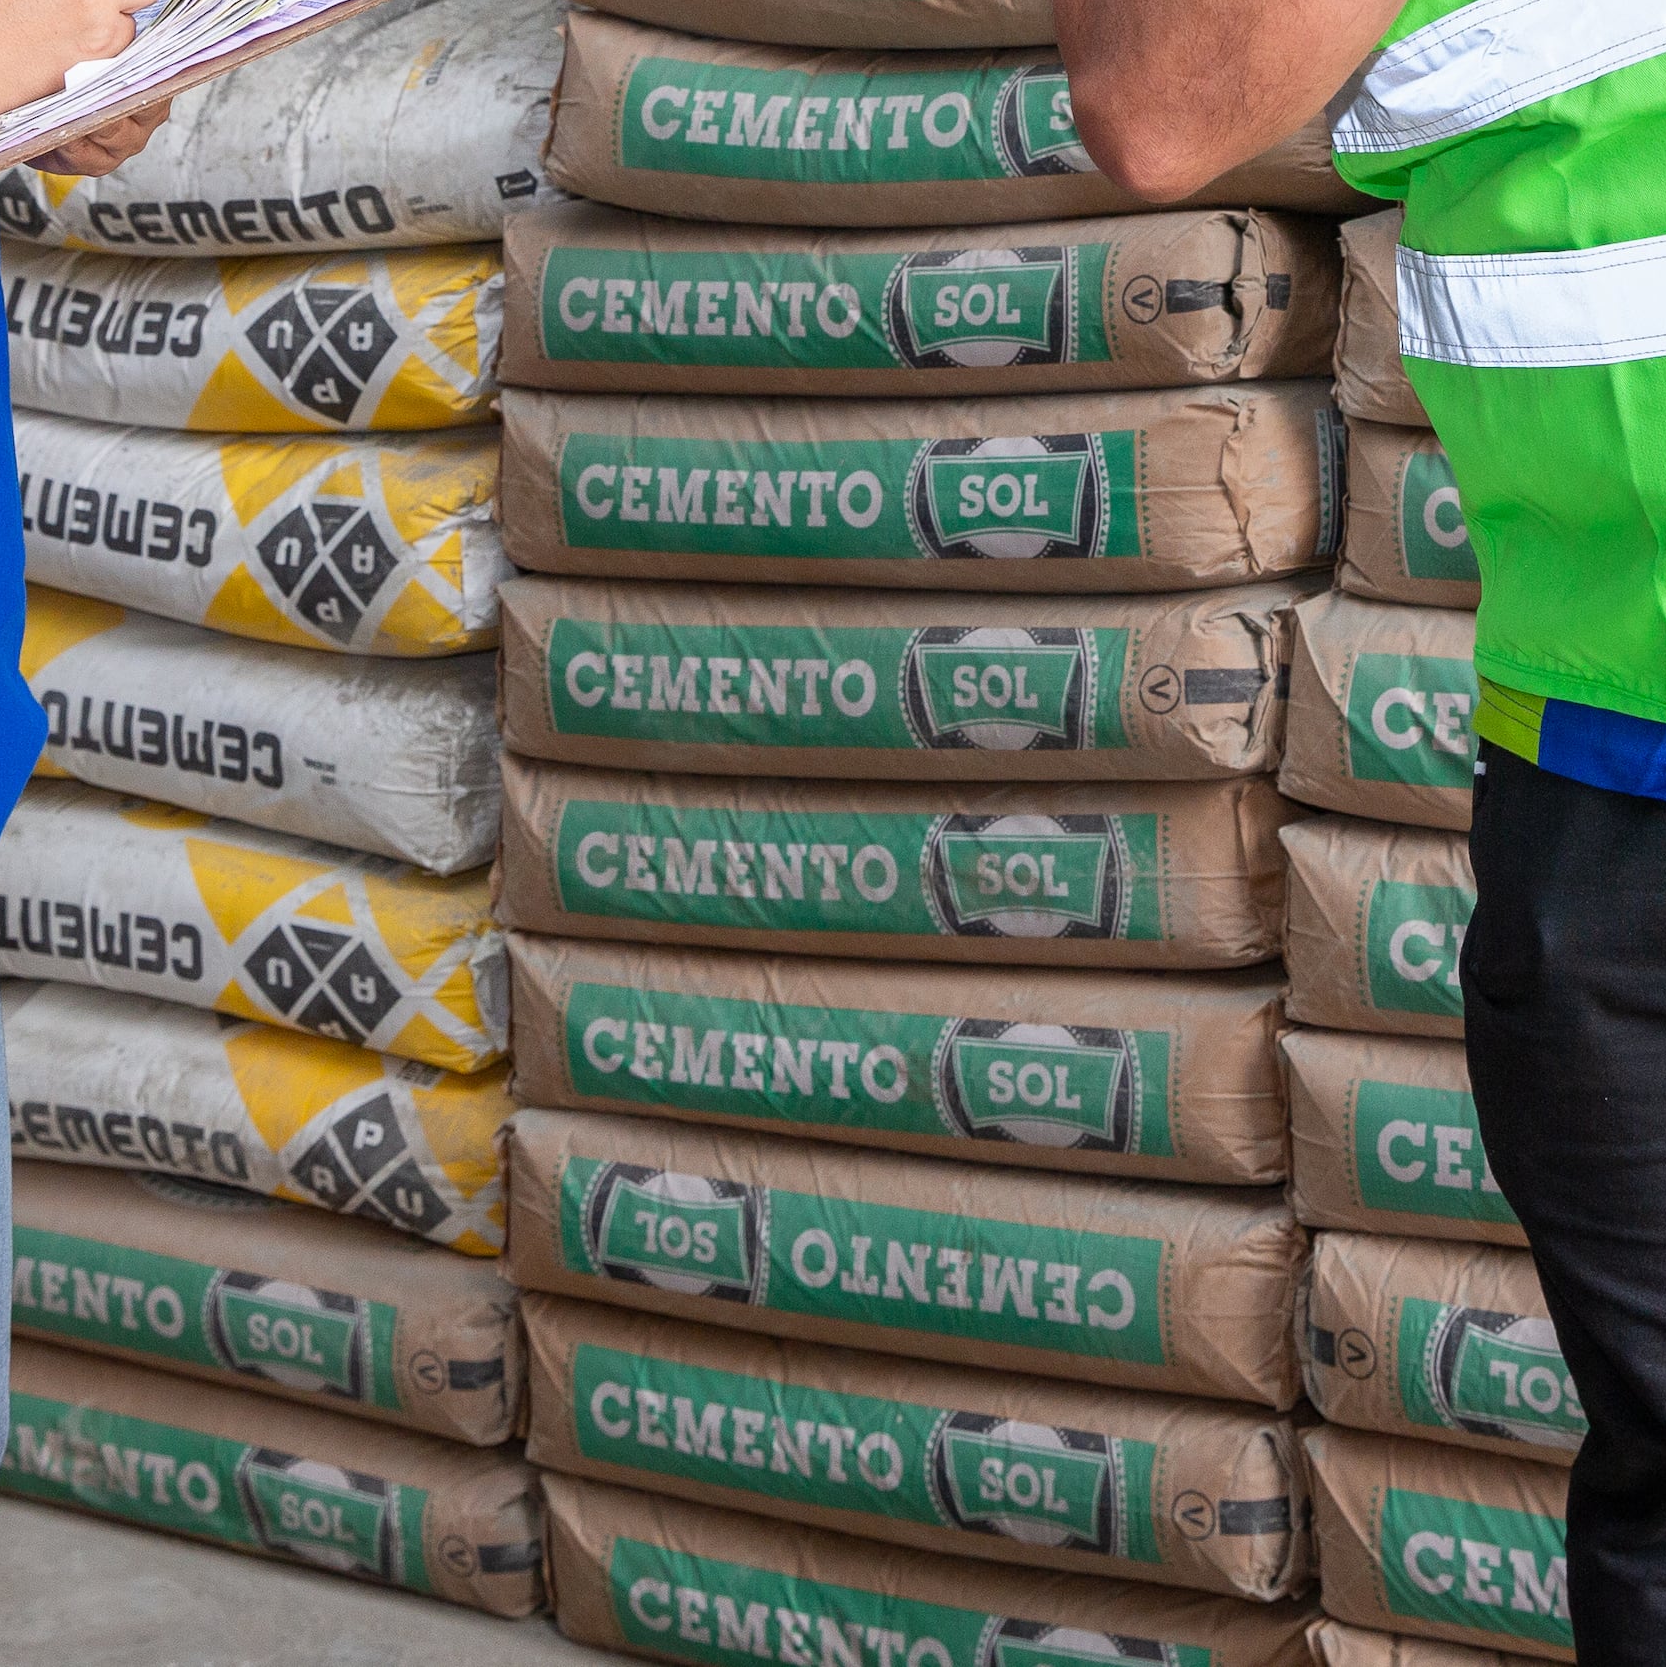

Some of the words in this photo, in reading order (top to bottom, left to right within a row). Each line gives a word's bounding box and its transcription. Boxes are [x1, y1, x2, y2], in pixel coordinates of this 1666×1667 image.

[641, 85, 970, 152] CEMENTO
[88, 185, 395, 245] CEMENTO
[7, 277, 209, 357] CEMENT
[558, 278, 861, 337] CEMENTO
[934, 283, 1021, 325] SOL
[21, 473, 217, 568] CEMENT
[576, 464, 883, 529] CEMENTO
[959, 473, 1049, 518] SOL
[565, 652, 877, 716] CEMENTO
[952, 663, 1038, 710] SOL
[41, 689, 283, 790] CEMENTO
[575, 831, 897, 902] CEMENTO
[978, 850, 1069, 898] SOL
[582, 1016, 908, 1104] CEMENTO
[987, 1060, 1080, 1110] SOL
[633, 1207, 718, 1263] SOL
[12, 1257, 184, 1338] MENTO
[246, 1313, 324, 1365] SOL
[791, 1227, 1133, 1332] CEMENTO
[2, 1424, 221, 1513] MENTO
[278, 1492, 356, 1543] SOL
[590, 1379, 904, 1493] CEMENTO
[979, 1458, 1069, 1517] SOL
